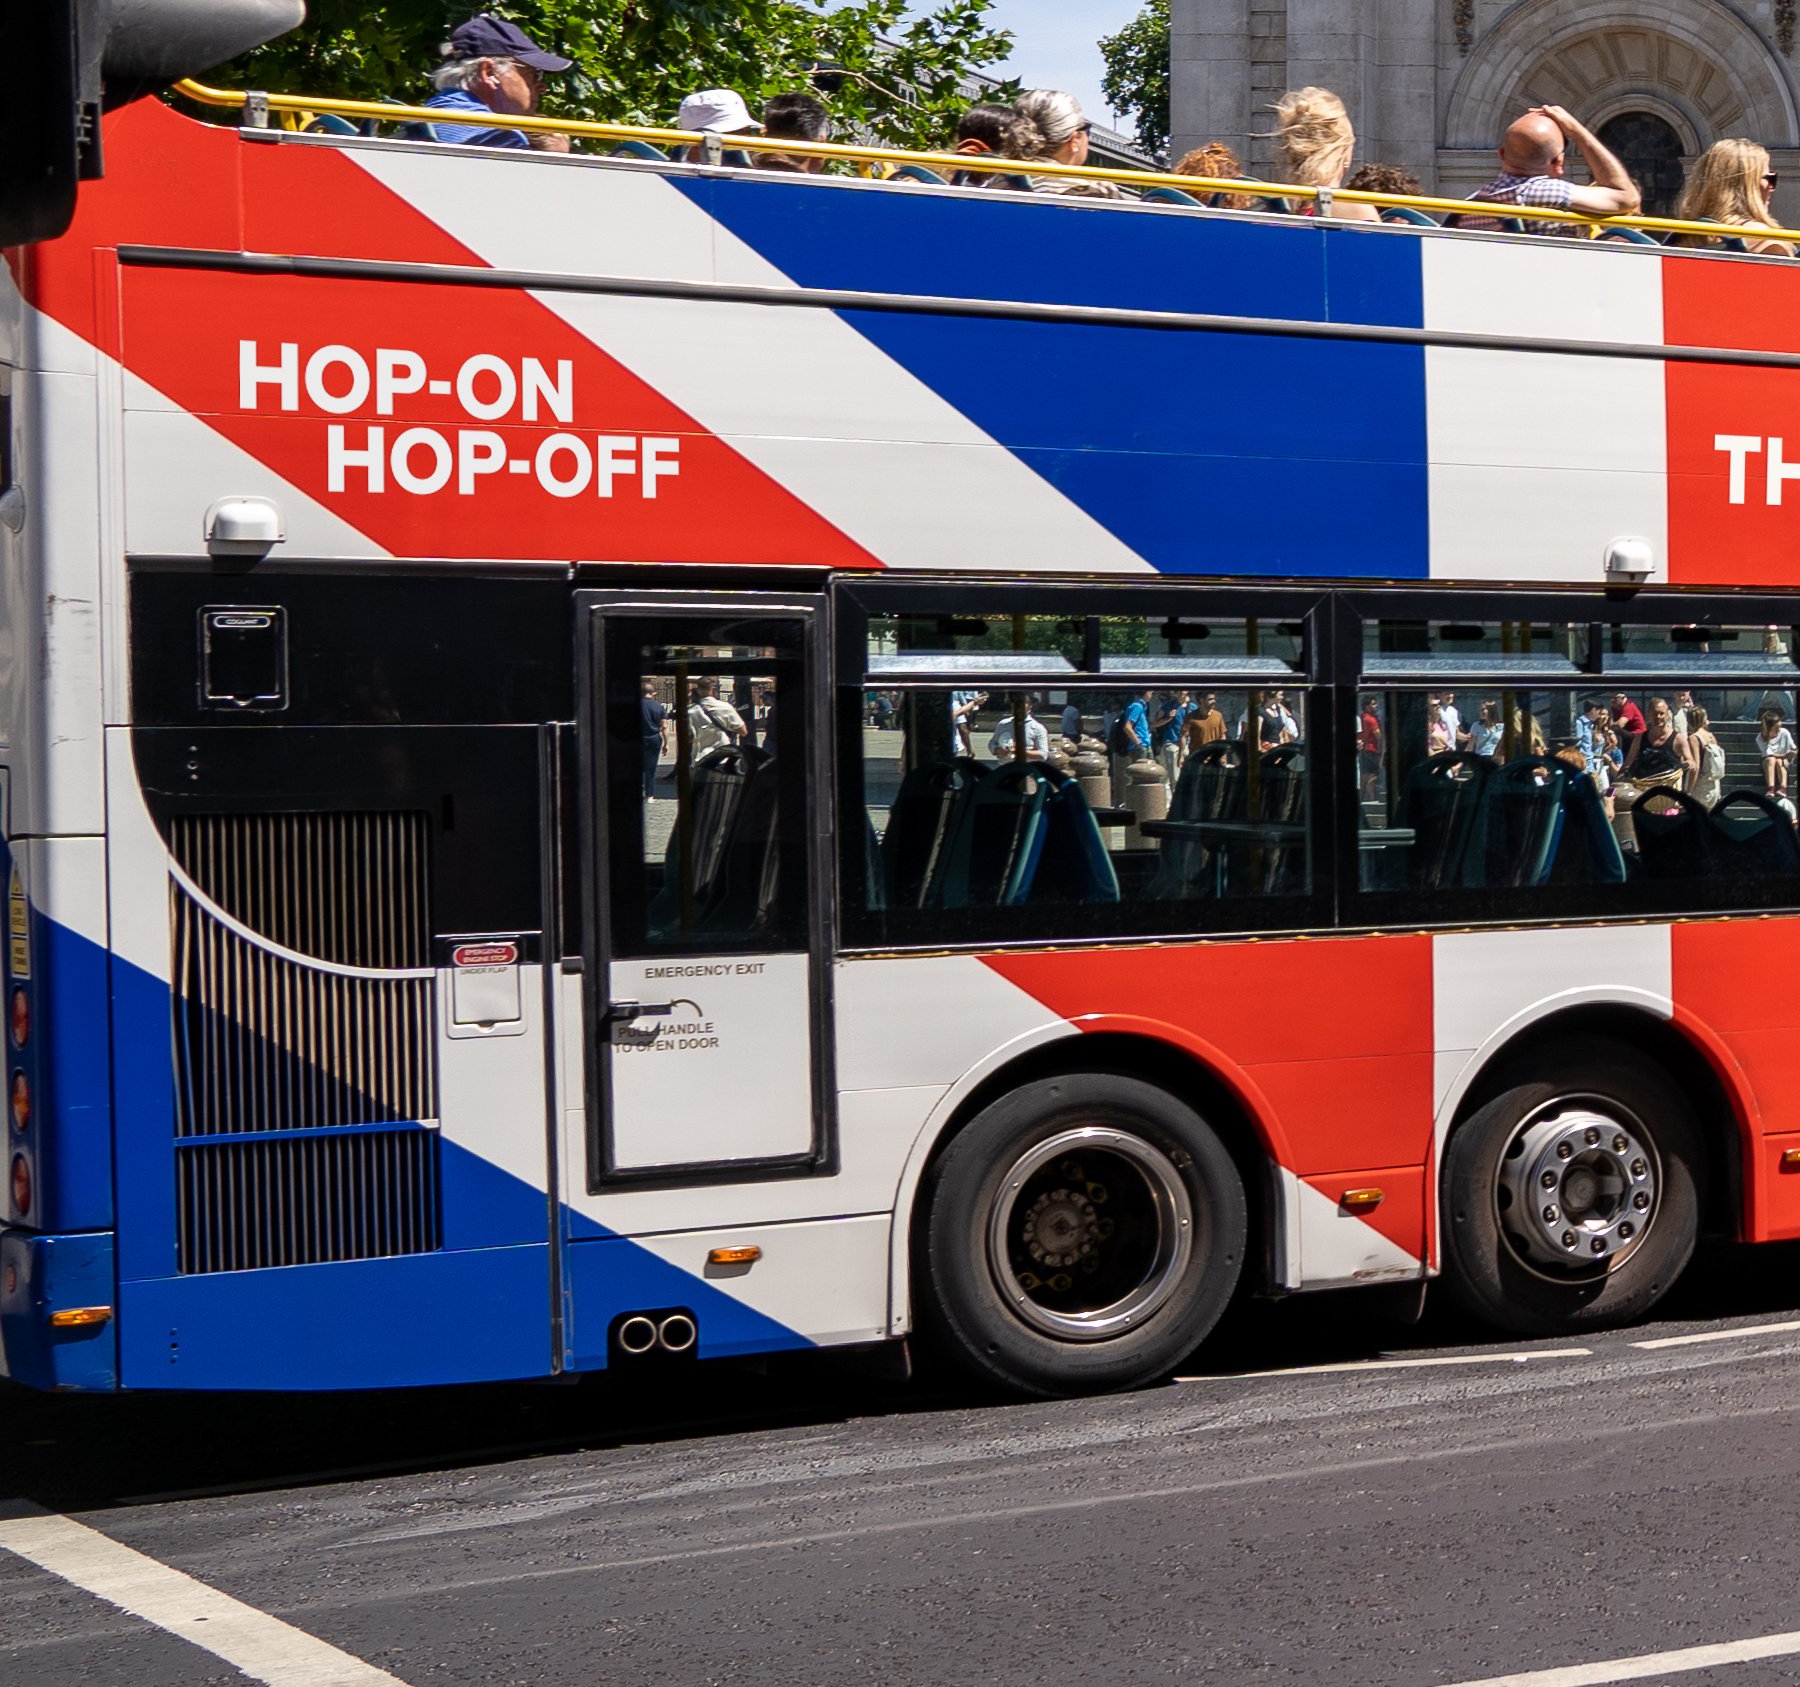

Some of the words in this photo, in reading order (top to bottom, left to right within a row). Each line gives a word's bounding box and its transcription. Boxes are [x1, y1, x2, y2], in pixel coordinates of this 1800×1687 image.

[239, 340, 573, 423] HOP-ON
[328, 425, 680, 499] HOP-OFF
[645, 964, 732, 979] EMERGENCY
[736, 963, 765, 975] EXIT
[618, 1025, 655, 1038] PULL
[659, 1022, 714, 1036] HANDLE
[614, 1043, 633, 1054] TO
[636, 1040, 674, 1053] OPEN
[678, 1037, 720, 1050] DOOR
